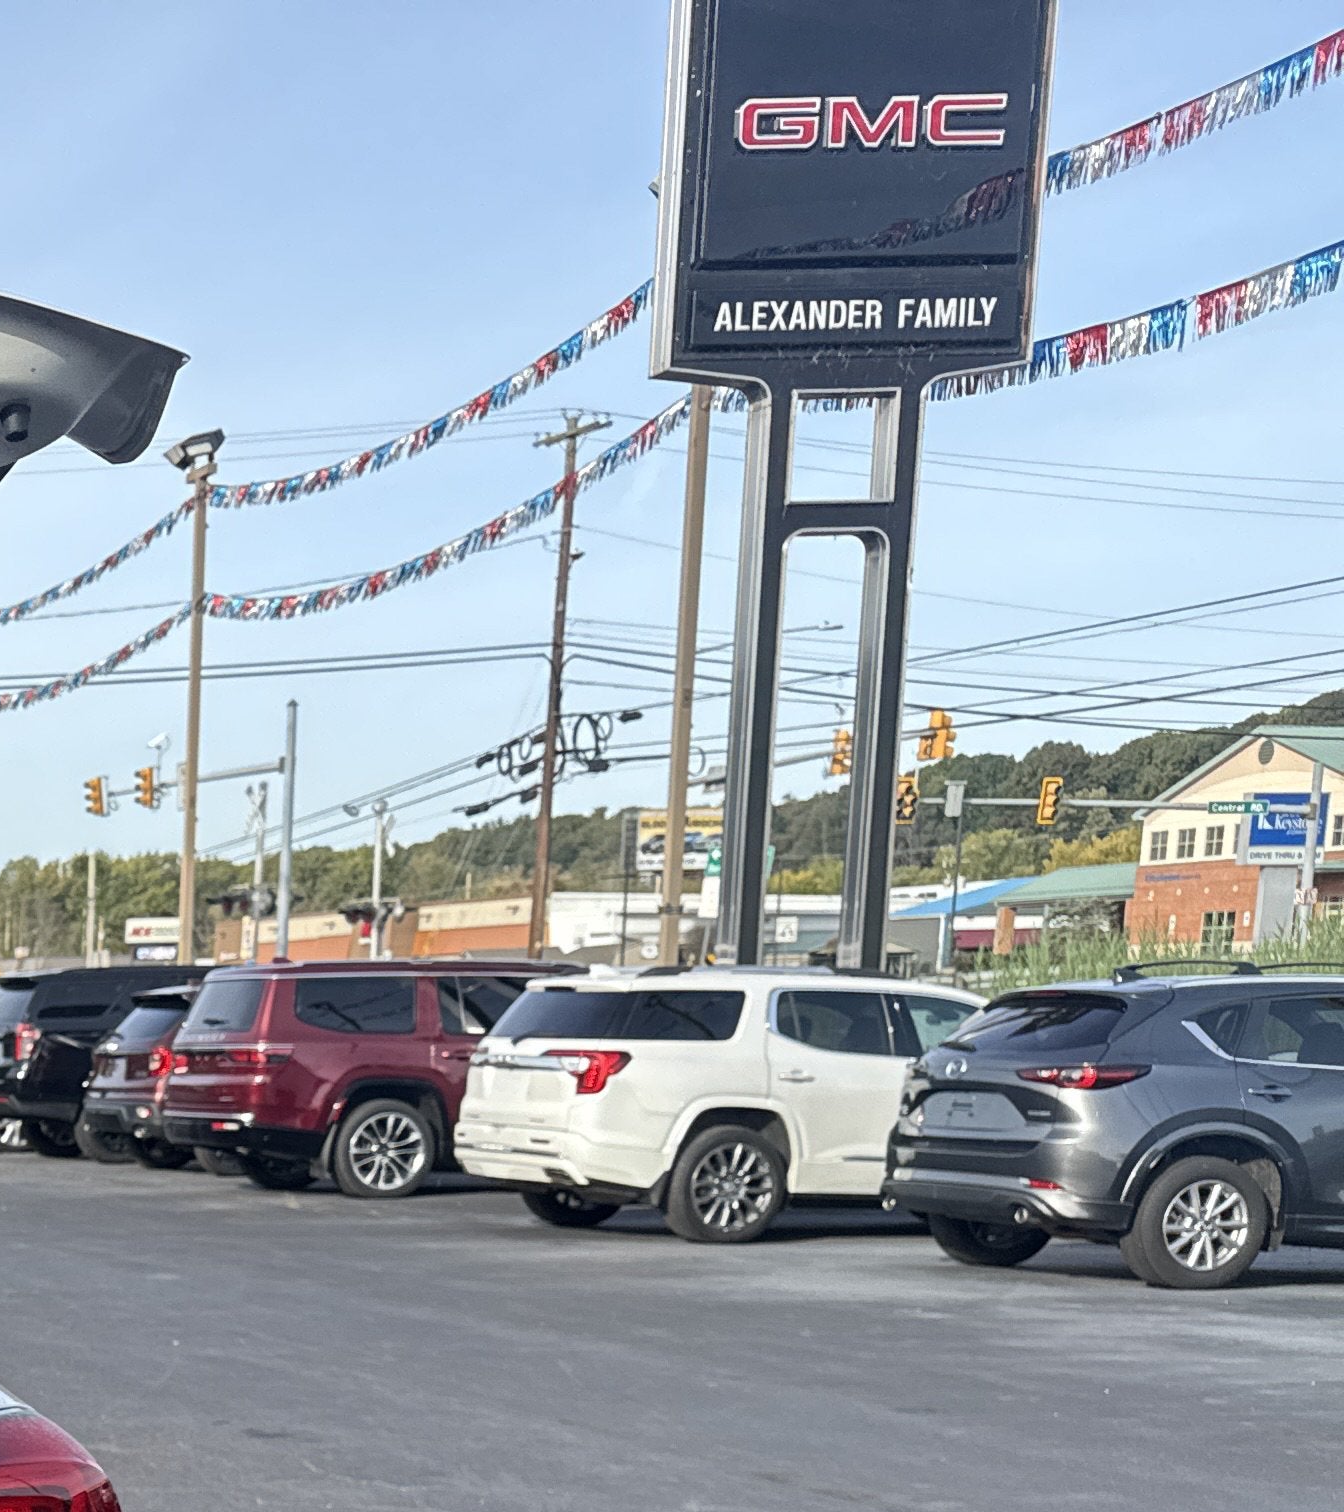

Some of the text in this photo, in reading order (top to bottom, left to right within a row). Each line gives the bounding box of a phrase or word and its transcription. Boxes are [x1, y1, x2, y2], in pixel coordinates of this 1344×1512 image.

[735, 93, 1008, 149] GMC
[714, 297, 998, 331] ALEXANDER FAMILY
[1212, 803, 1245, 813] Central
[1250, 852, 1272, 860] DRIVE
